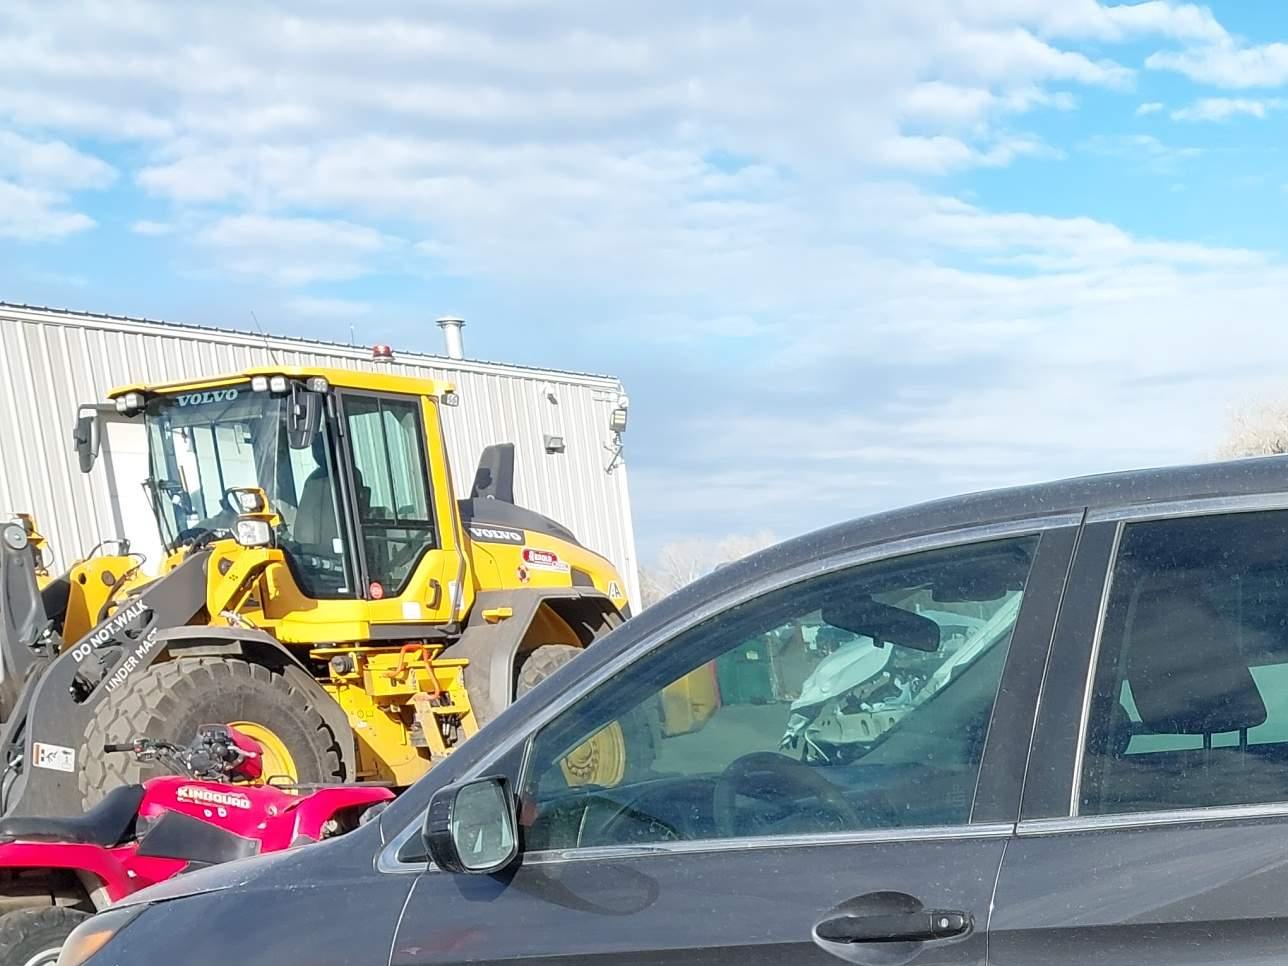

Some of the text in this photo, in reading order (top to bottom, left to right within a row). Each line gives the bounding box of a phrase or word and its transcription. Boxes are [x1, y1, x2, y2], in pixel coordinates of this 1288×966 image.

[175, 388, 239, 407] VOLVO
[470, 527, 523, 541] VOLVO
[71, 599, 149, 662] DO NOT WALK
[105, 626, 158, 692] UNDER MAST
